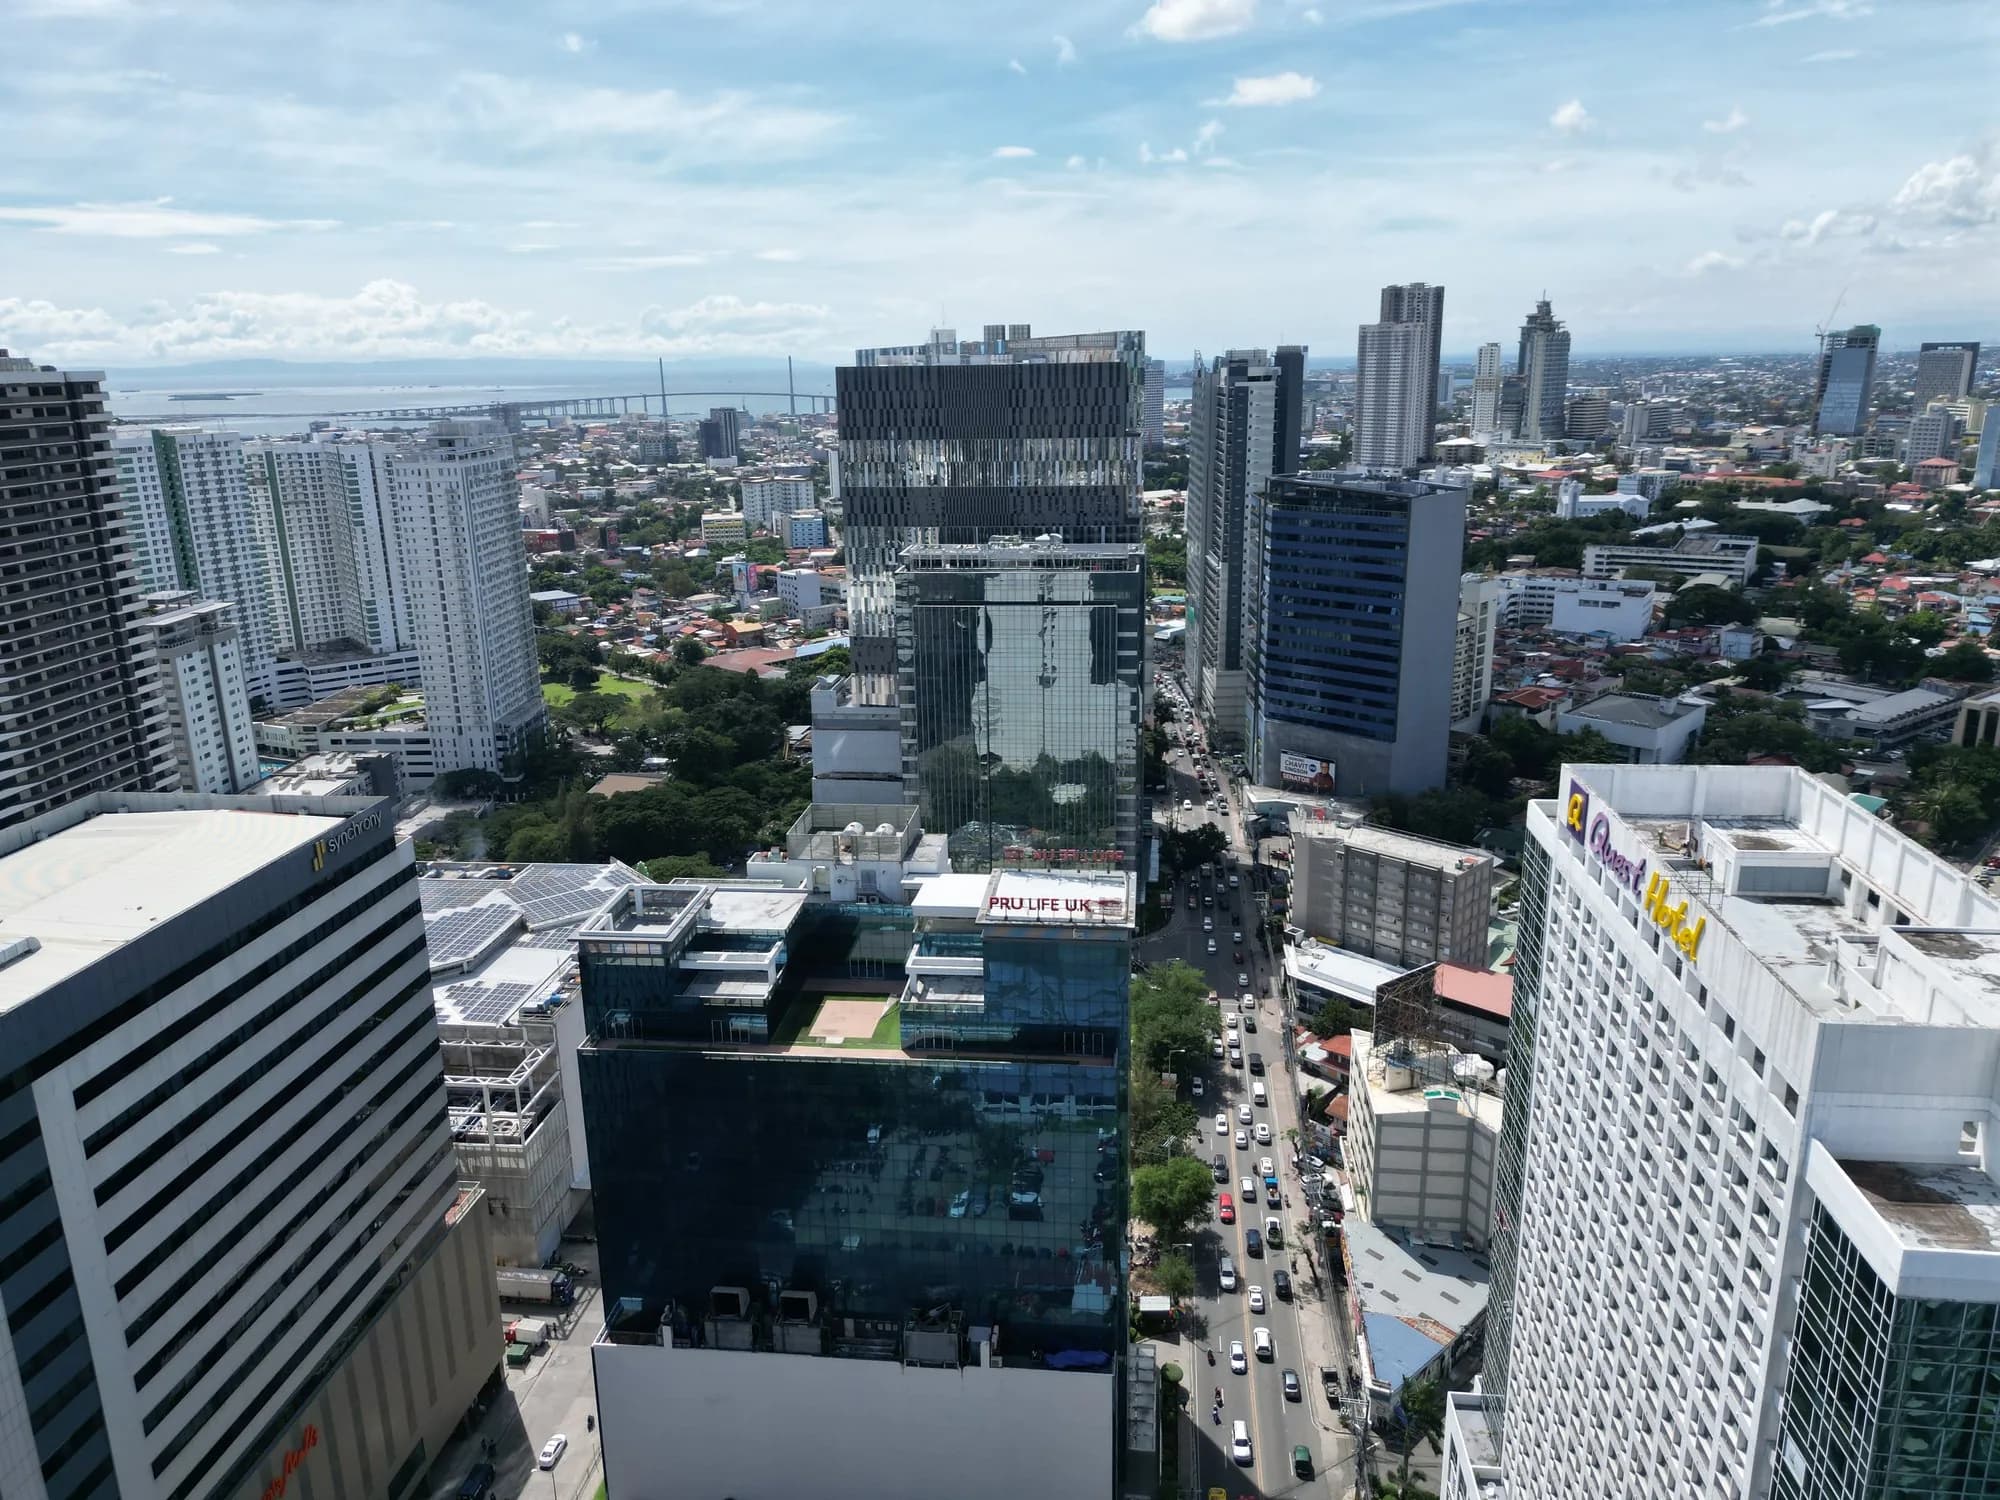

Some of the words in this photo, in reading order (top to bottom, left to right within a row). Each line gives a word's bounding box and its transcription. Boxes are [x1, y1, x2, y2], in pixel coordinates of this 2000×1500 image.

[1282, 772, 1310, 783] SENATOR
[328, 810, 382, 853] synchrony
[1589, 811, 1646, 896] Quest
[1645, 871, 1706, 961] Hotel
[989, 897, 1023, 910] PRU
[1028, 898, 1060, 911] LIFE
